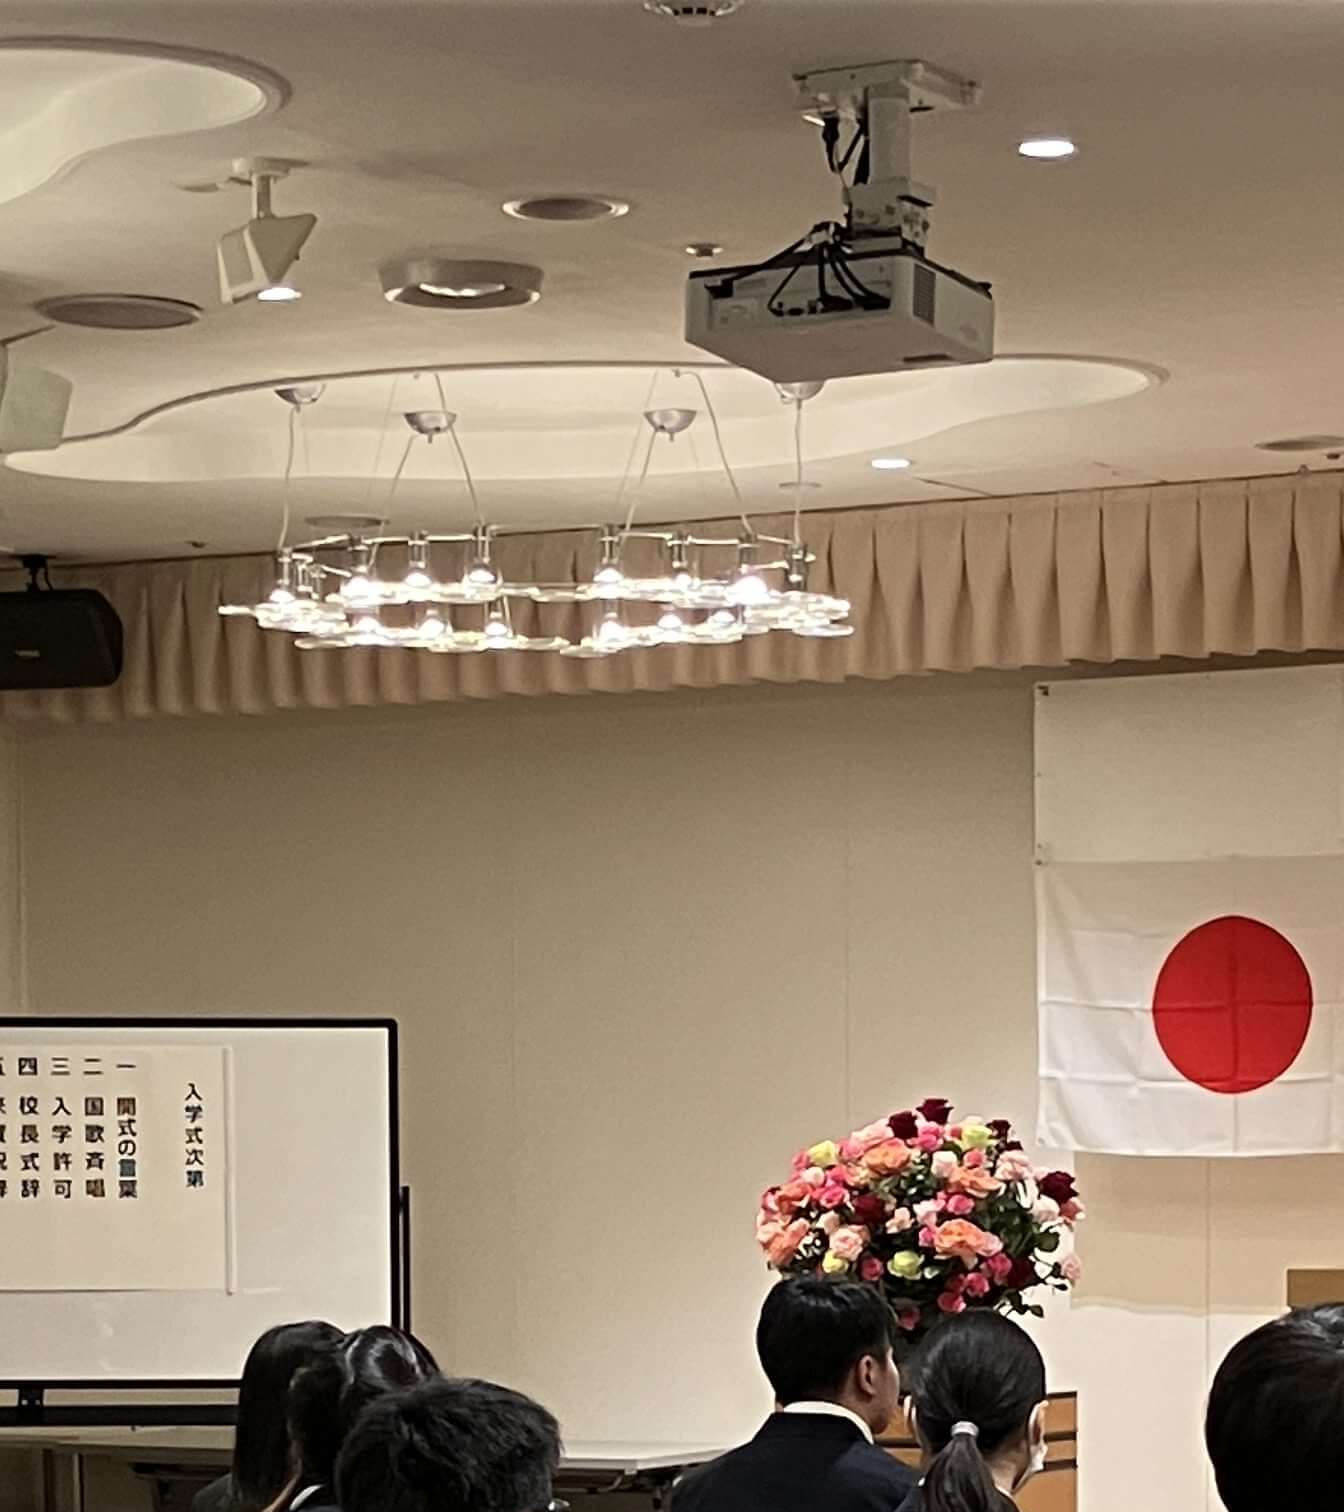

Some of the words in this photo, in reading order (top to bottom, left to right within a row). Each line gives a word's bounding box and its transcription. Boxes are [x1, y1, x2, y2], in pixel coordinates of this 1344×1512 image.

[51, 1096, 73, 1199] 入学許可
[185, 1082, 205, 1188] 入学式次第
